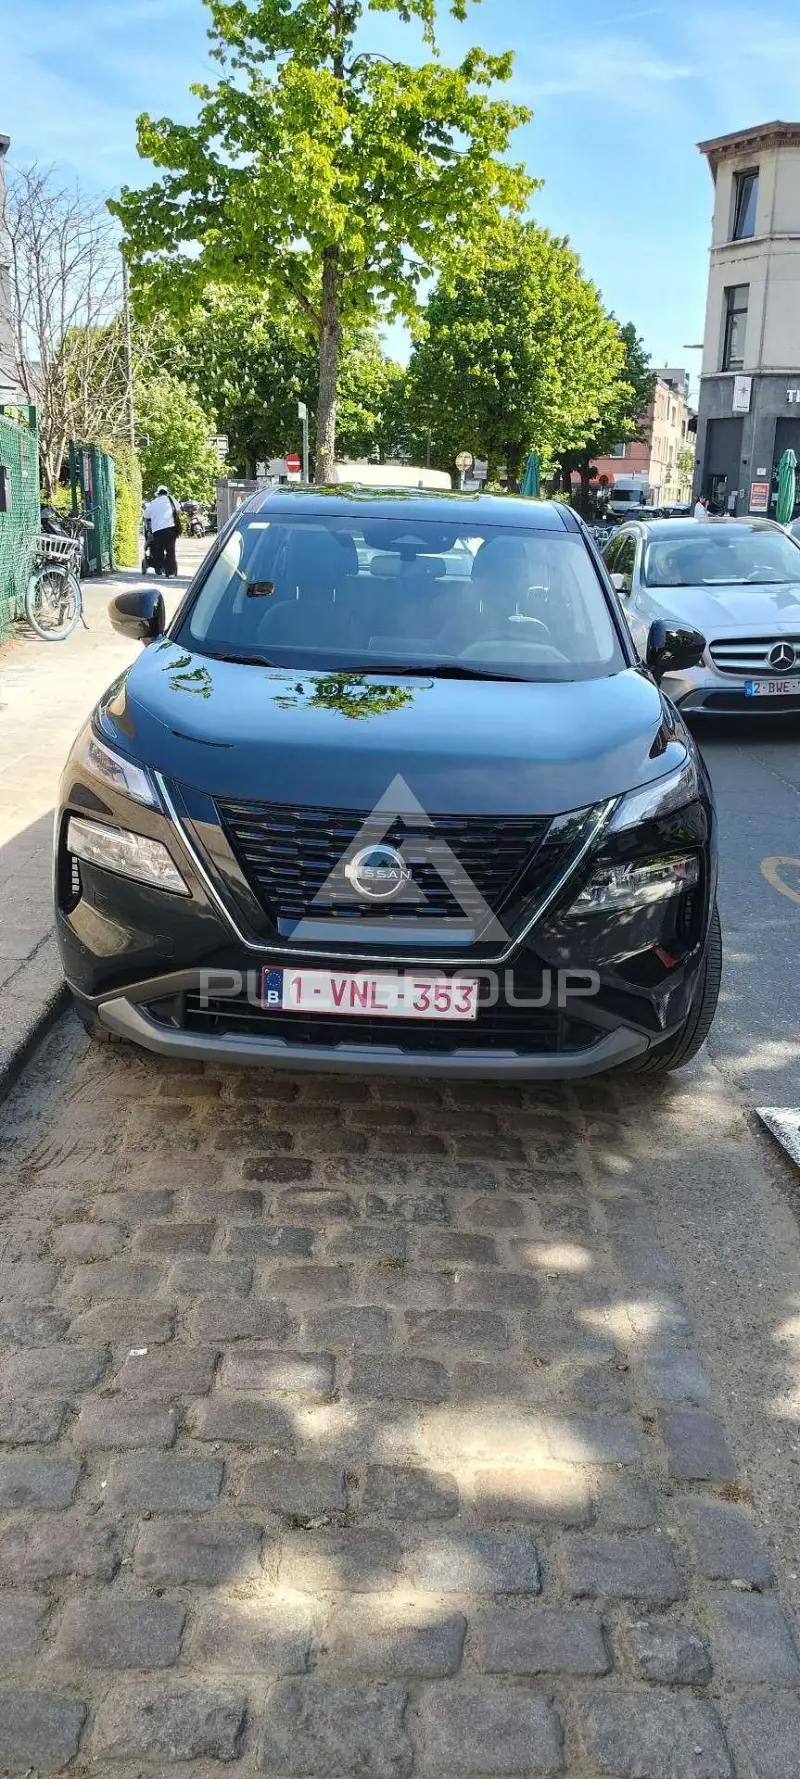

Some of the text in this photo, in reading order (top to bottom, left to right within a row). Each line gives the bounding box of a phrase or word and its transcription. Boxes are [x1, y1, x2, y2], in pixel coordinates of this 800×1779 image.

[753, 681, 800, 694] 2-BWE-
[346, 867, 411, 880] SSAN
[267, 976, 474, 1013] B 1-VNL-353
